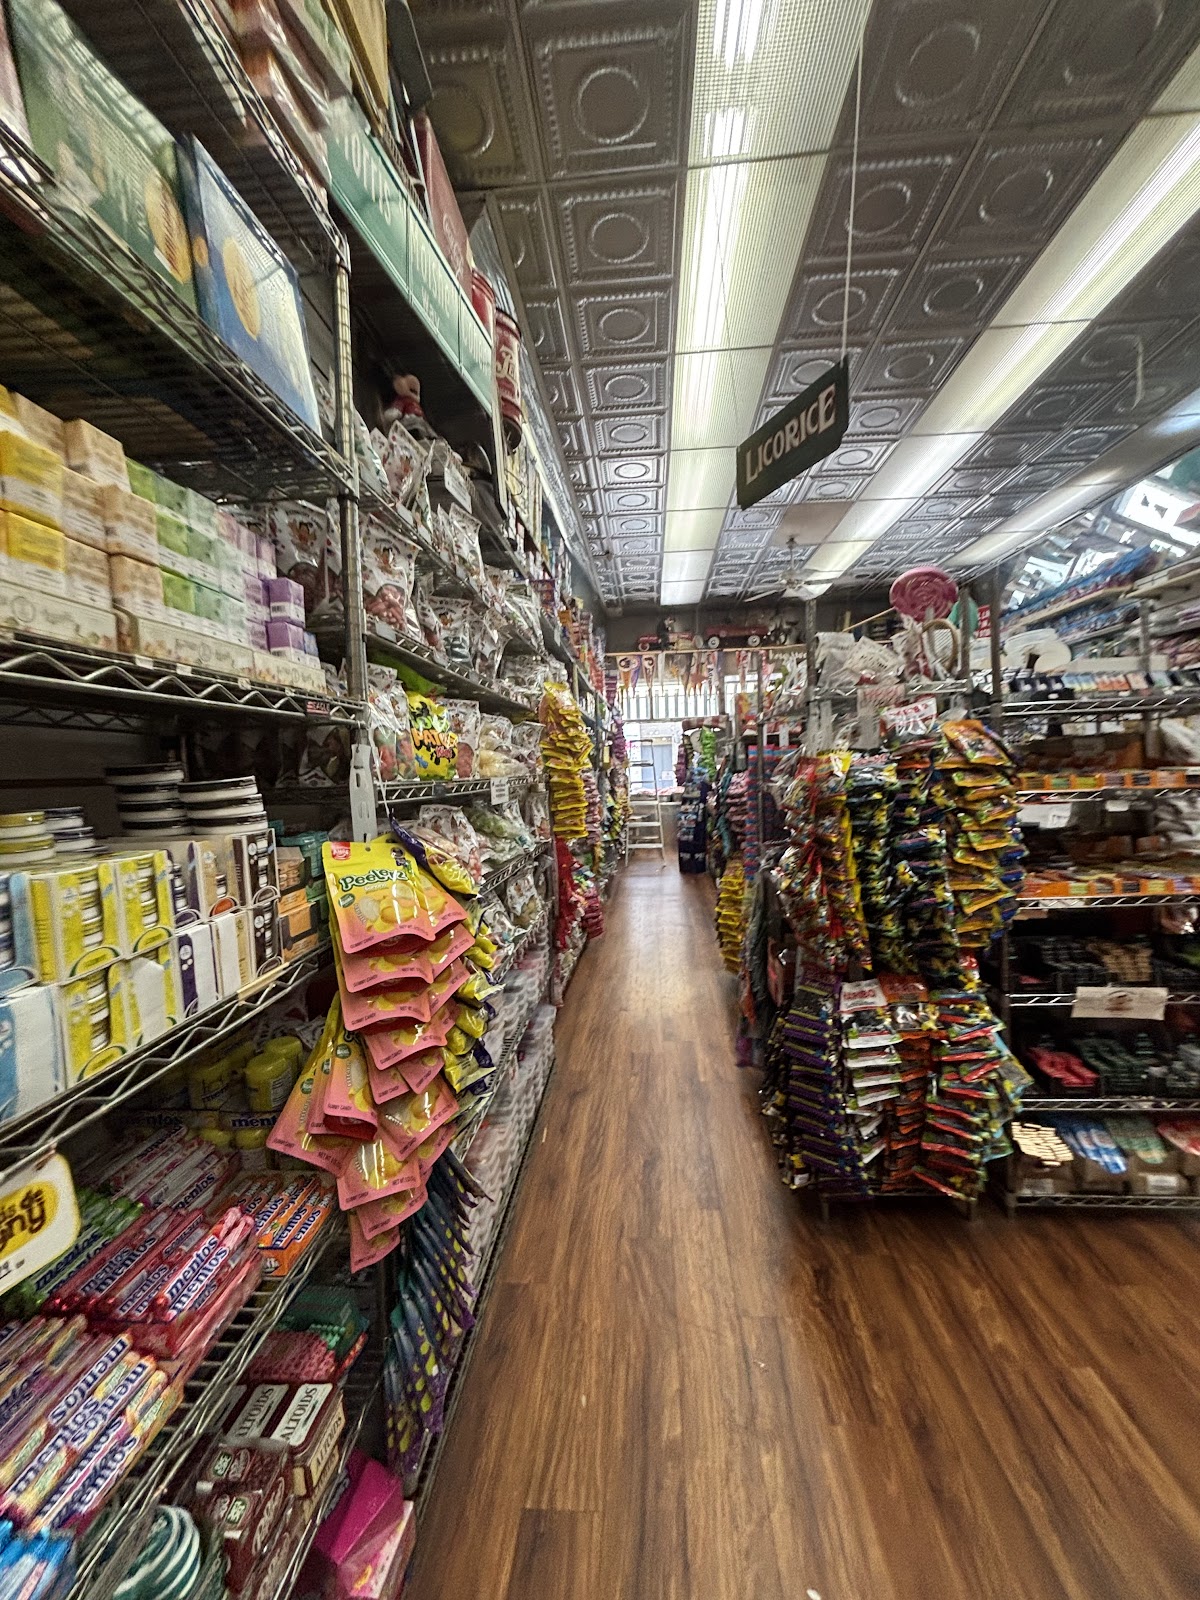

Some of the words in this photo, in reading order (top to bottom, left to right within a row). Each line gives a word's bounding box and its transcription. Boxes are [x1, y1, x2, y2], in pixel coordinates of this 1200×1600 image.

[745, 383, 836, 485] LICORICE
[231, 1116, 277, 1128] ment
[256, 1197, 285, 1235] entos
[295, 1209, 321, 1240] entos
[95, 1237, 157, 1293] mentos
[118, 1264, 169, 1314] mentos
[167, 1237, 219, 1299] mentos
[170, 1247, 229, 1313] mentos
[50, 1338, 128, 1424] mentos
[70, 1362, 148, 1446] mentos
[281, 1386, 318, 1440] ALTOIDS
[10, 1399, 99, 1495] mentos
